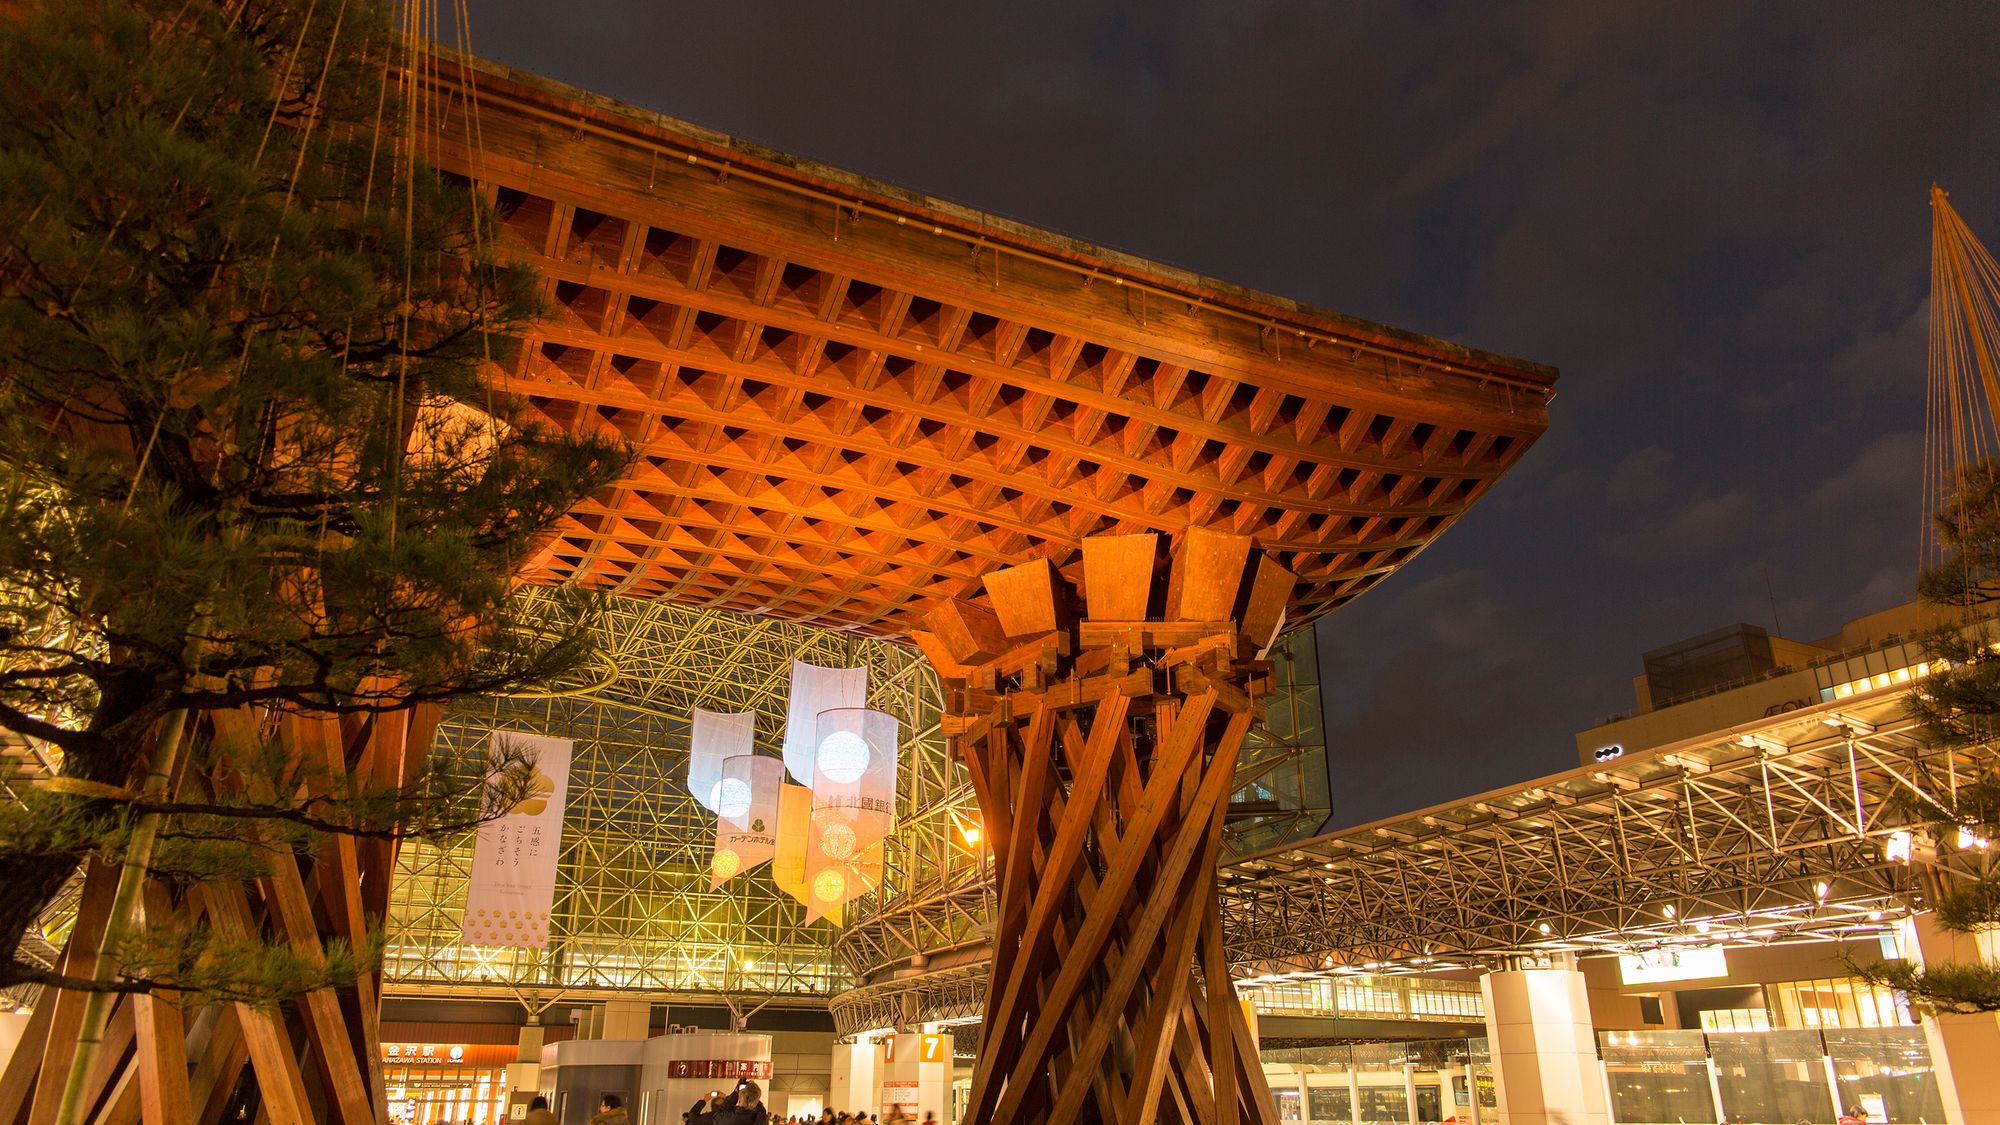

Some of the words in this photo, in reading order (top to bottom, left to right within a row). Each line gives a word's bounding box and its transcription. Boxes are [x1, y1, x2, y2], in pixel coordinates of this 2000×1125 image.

[496, 824, 510, 866] かなざわ
[513, 825, 527, 867] ごちそう
[529, 826, 542, 857] 五感に
[382, 1056, 415, 1064] ANAZAWA
[387, 1045, 436, 1057] 金沢駅
[924, 1037, 940, 1060] 7
